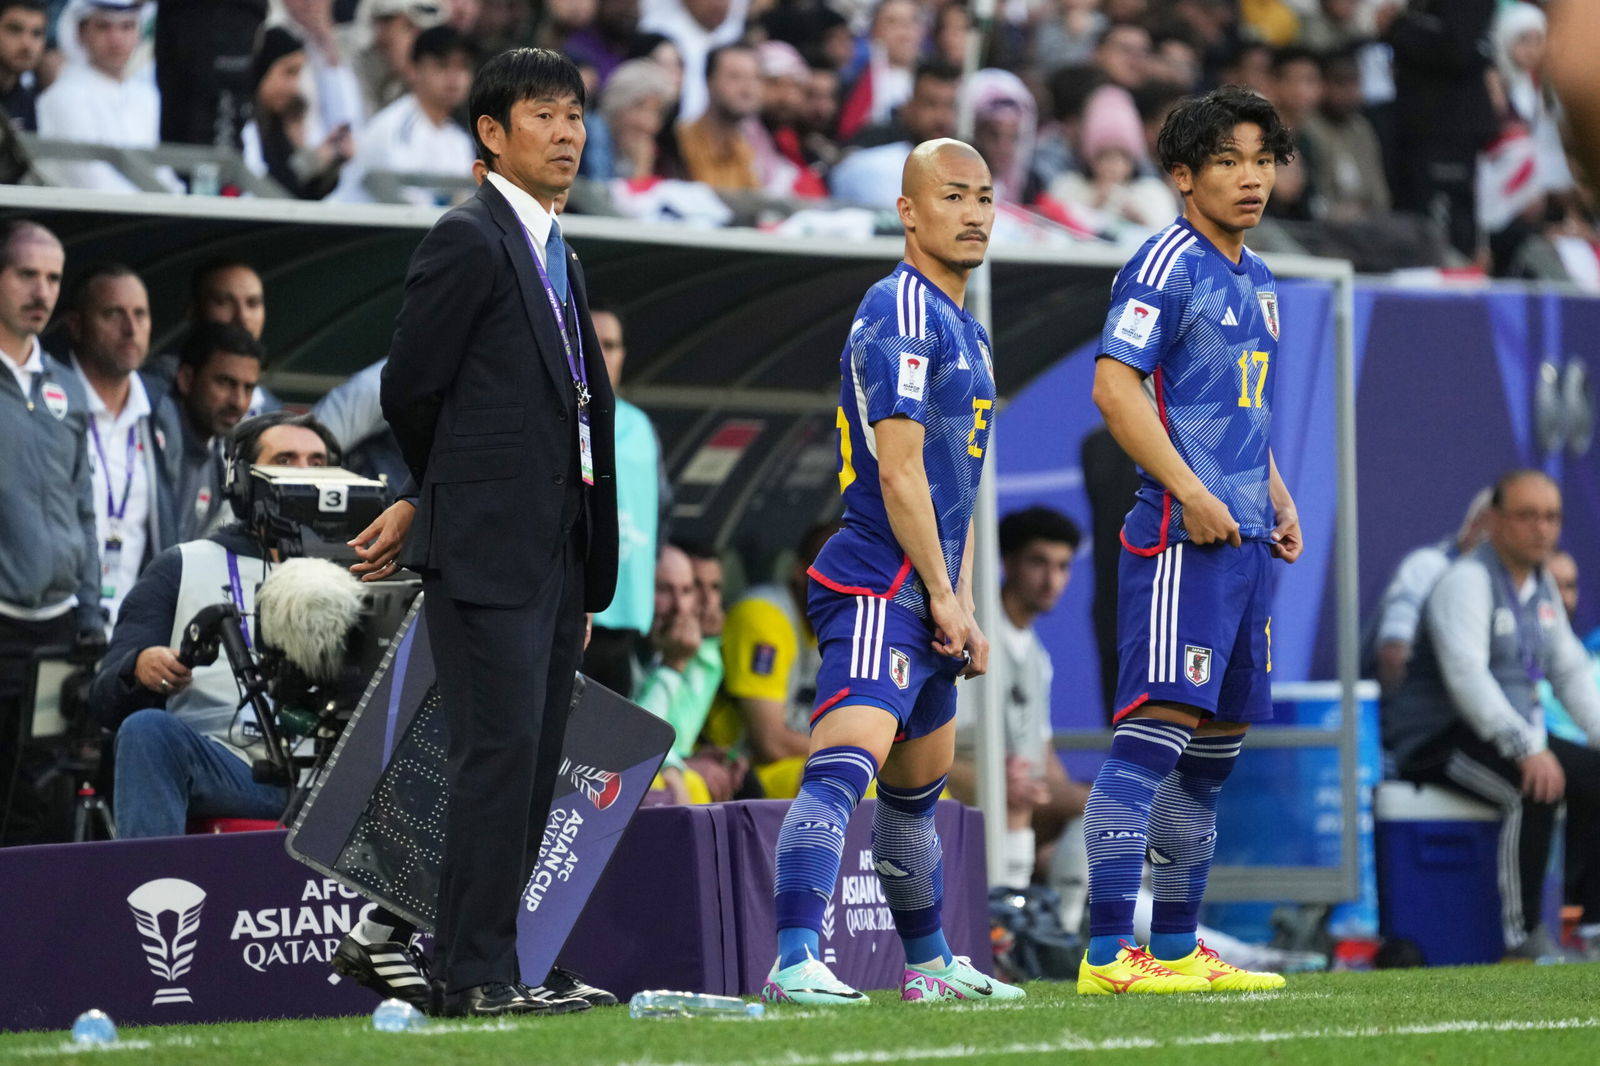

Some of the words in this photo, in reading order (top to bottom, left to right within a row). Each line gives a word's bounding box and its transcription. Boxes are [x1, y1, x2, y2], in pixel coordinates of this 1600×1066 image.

[1238, 350, 1269, 408] 17
[325, 490, 342, 507] 3
[544, 808, 584, 872] ASIAN
[557, 851, 579, 883] AFC
[526, 870, 552, 912] CUP
[842, 875, 876, 905] ASIAN
[229, 903, 351, 940] ASIAN
[846, 908, 877, 937] QATAR
[876, 906, 897, 931] 202
